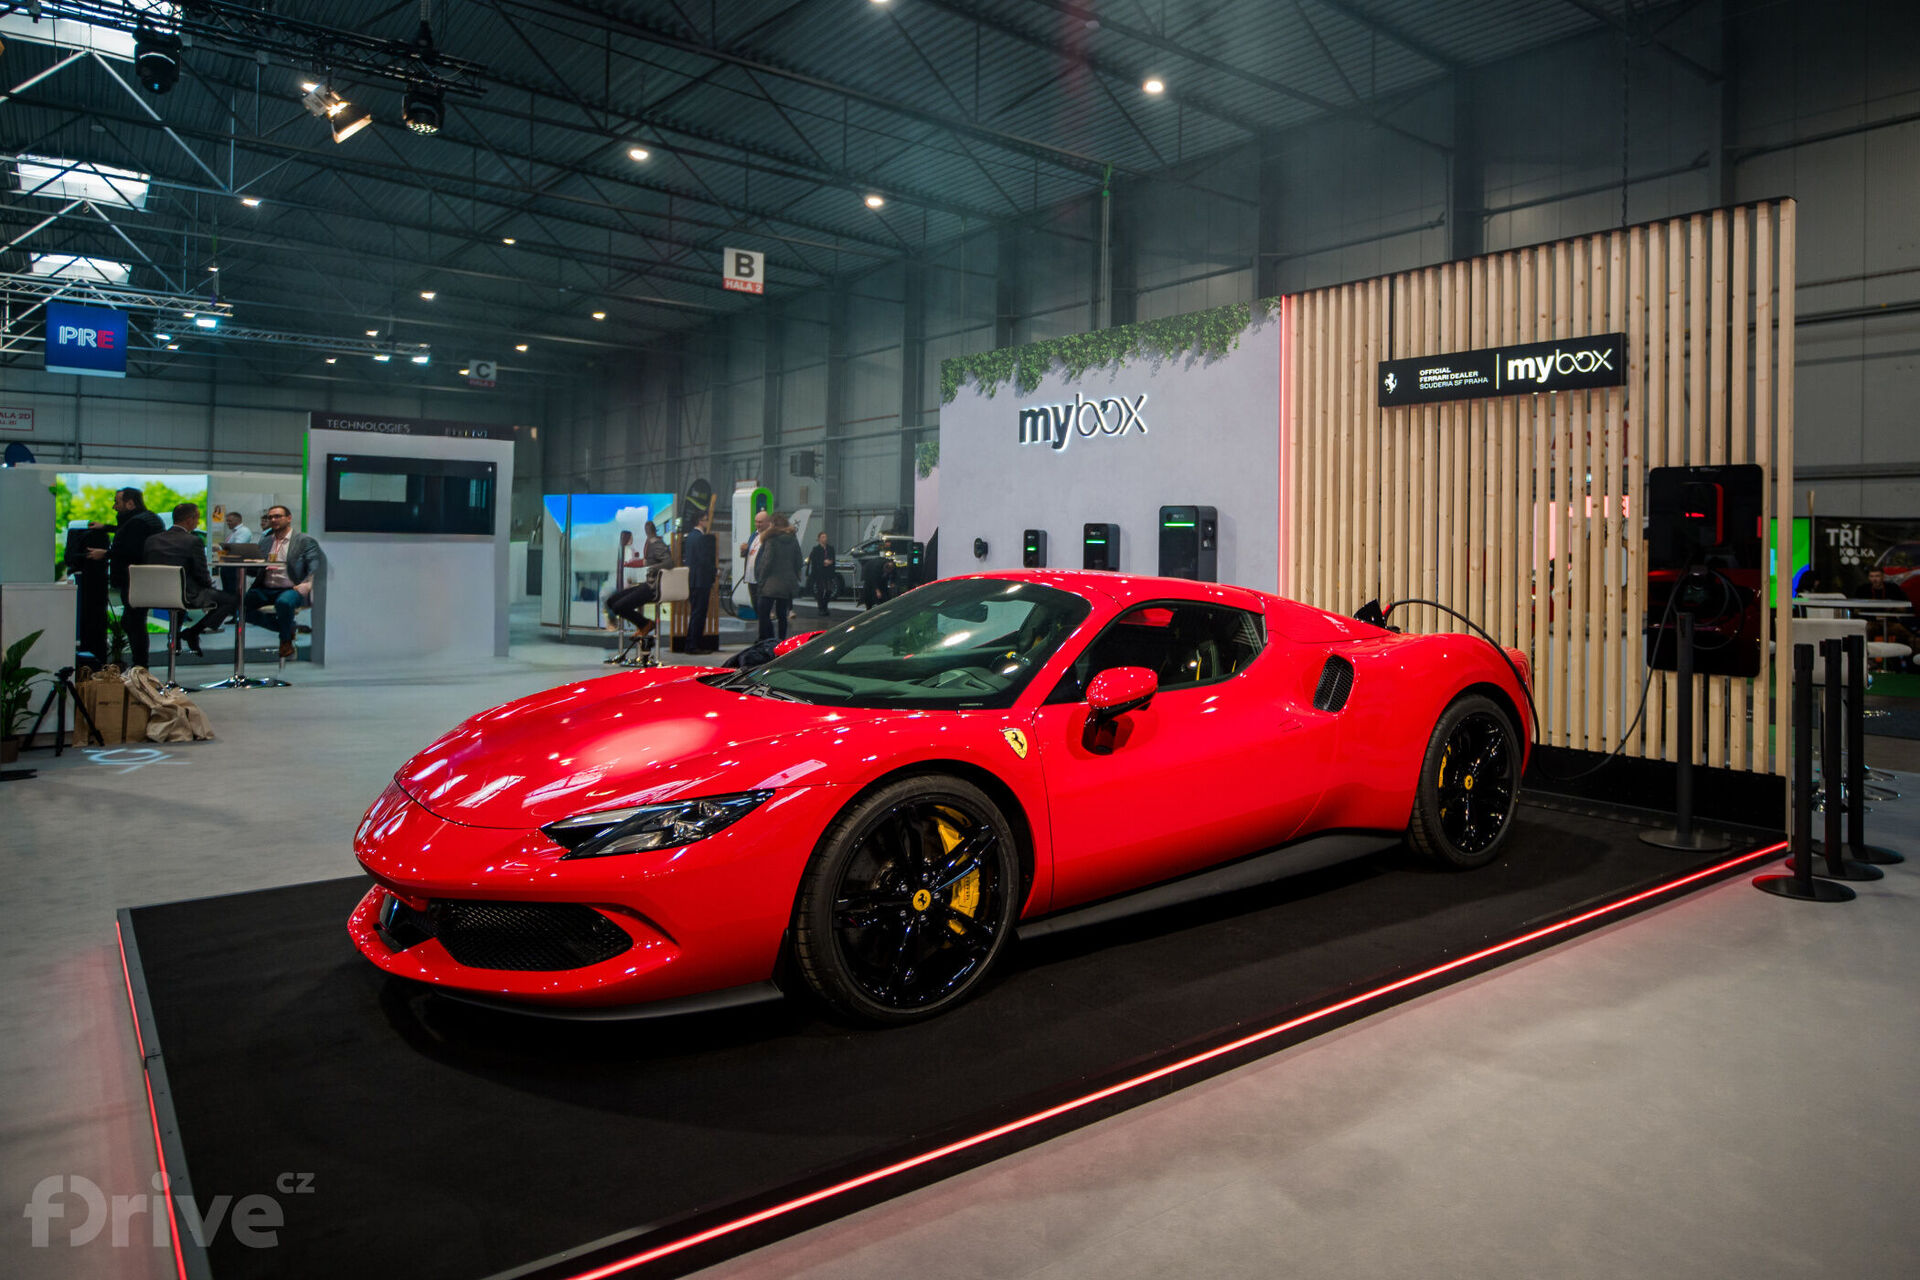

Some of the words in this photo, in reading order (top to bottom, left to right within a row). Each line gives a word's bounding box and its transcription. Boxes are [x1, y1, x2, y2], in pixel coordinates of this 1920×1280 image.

[735, 253, 755, 278] B
[725, 279, 752, 290] HALA
[755, 283, 761, 292] 2
[59, 325, 114, 349] PRE
[476, 362, 491, 378] C
[1419, 367, 1451, 376] OFFICIAL
[1507, 348, 1613, 383] mybox
[1419, 374, 1449, 383] FERRARI
[1450, 370, 1479, 380] DEALER
[1419, 381, 1453, 390] SCUDERIA
[1464, 376, 1488, 385] PRAHA
[327, 418, 411, 433] TECHNOLOGIES
[1019, 392, 1149, 450] mybox
[1825, 524, 1862, 547] TŘÍ
